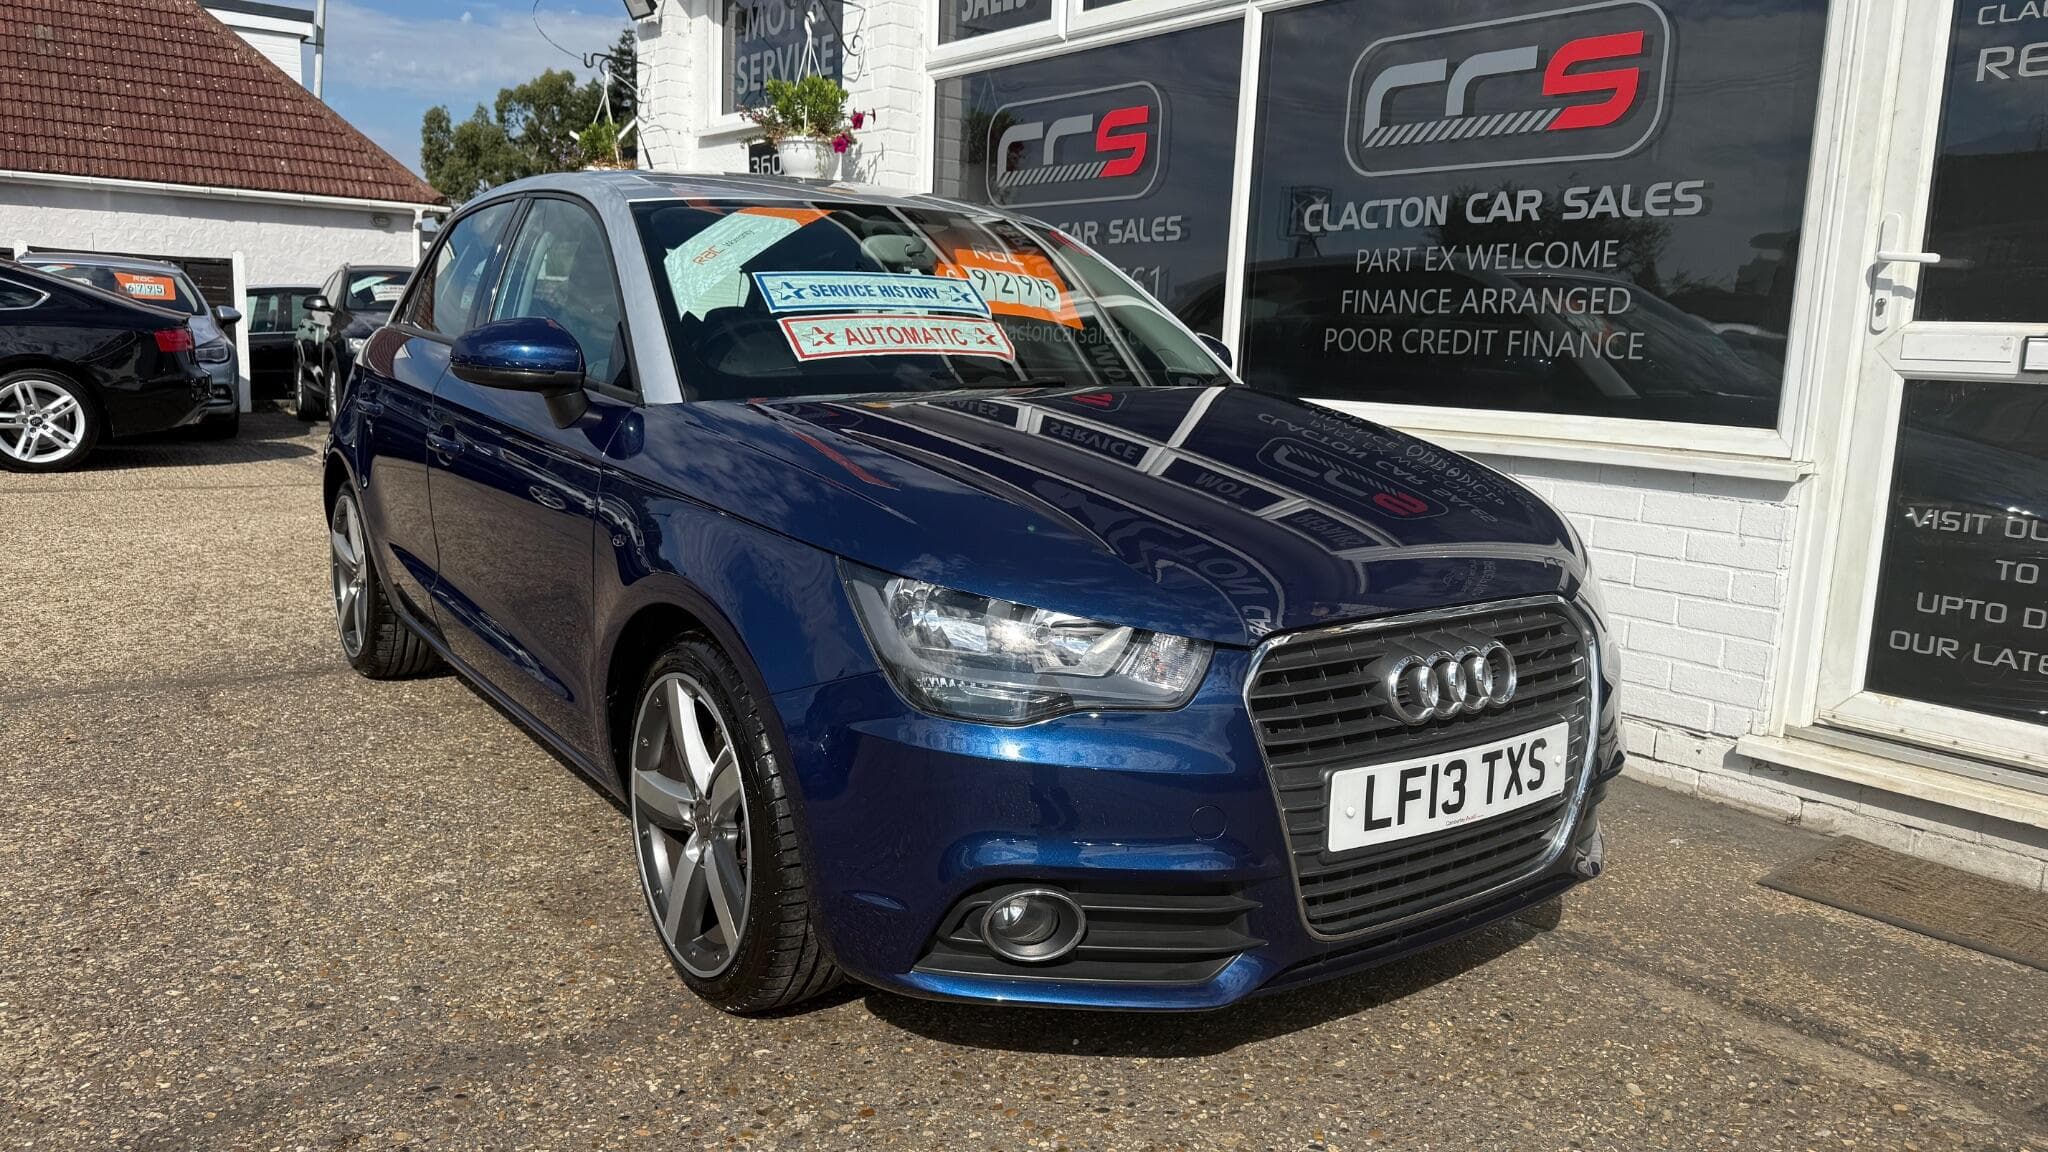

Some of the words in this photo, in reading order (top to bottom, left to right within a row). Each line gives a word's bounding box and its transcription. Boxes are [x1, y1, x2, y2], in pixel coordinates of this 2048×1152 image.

[744, 0, 795, 42] MOT
[1977, 1, 2048, 25] CLA
[736, 34, 834, 95] SERVICE
[1303, 194, 1448, 233] CLACTON
[1466, 189, 1543, 223] CAR
[1562, 180, 1705, 220] SALES
[1108, 215, 1181, 244] SALES
[1355, 246, 1416, 273] PART
[1425, 244, 1456, 271] EX
[1465, 239, 1619, 271] WELCOME
[127, 284, 163, 294] 6795
[808, 284, 878, 299] SERVICE
[879, 285, 941, 300] HISTORY
[1119, 265, 1160, 299] 61
[1340, 289, 1452, 315] FINANCE
[1459, 287, 1631, 315] ARRANGED
[844, 326, 968, 346] AUTOMATIC
[1324, 328, 1394, 353] POOR
[1402, 330, 1498, 355] CREDIT
[1507, 331, 1645, 360] FINANCE
[1908, 506, 1992, 535] VISIT
[1995, 559, 2039, 584] TO
[1916, 591, 2008, 624] UPTO
[1889, 630, 1959, 660] OUR
[1364, 758, 1467, 831] LF13
[1482, 738, 1547, 804] TXS
